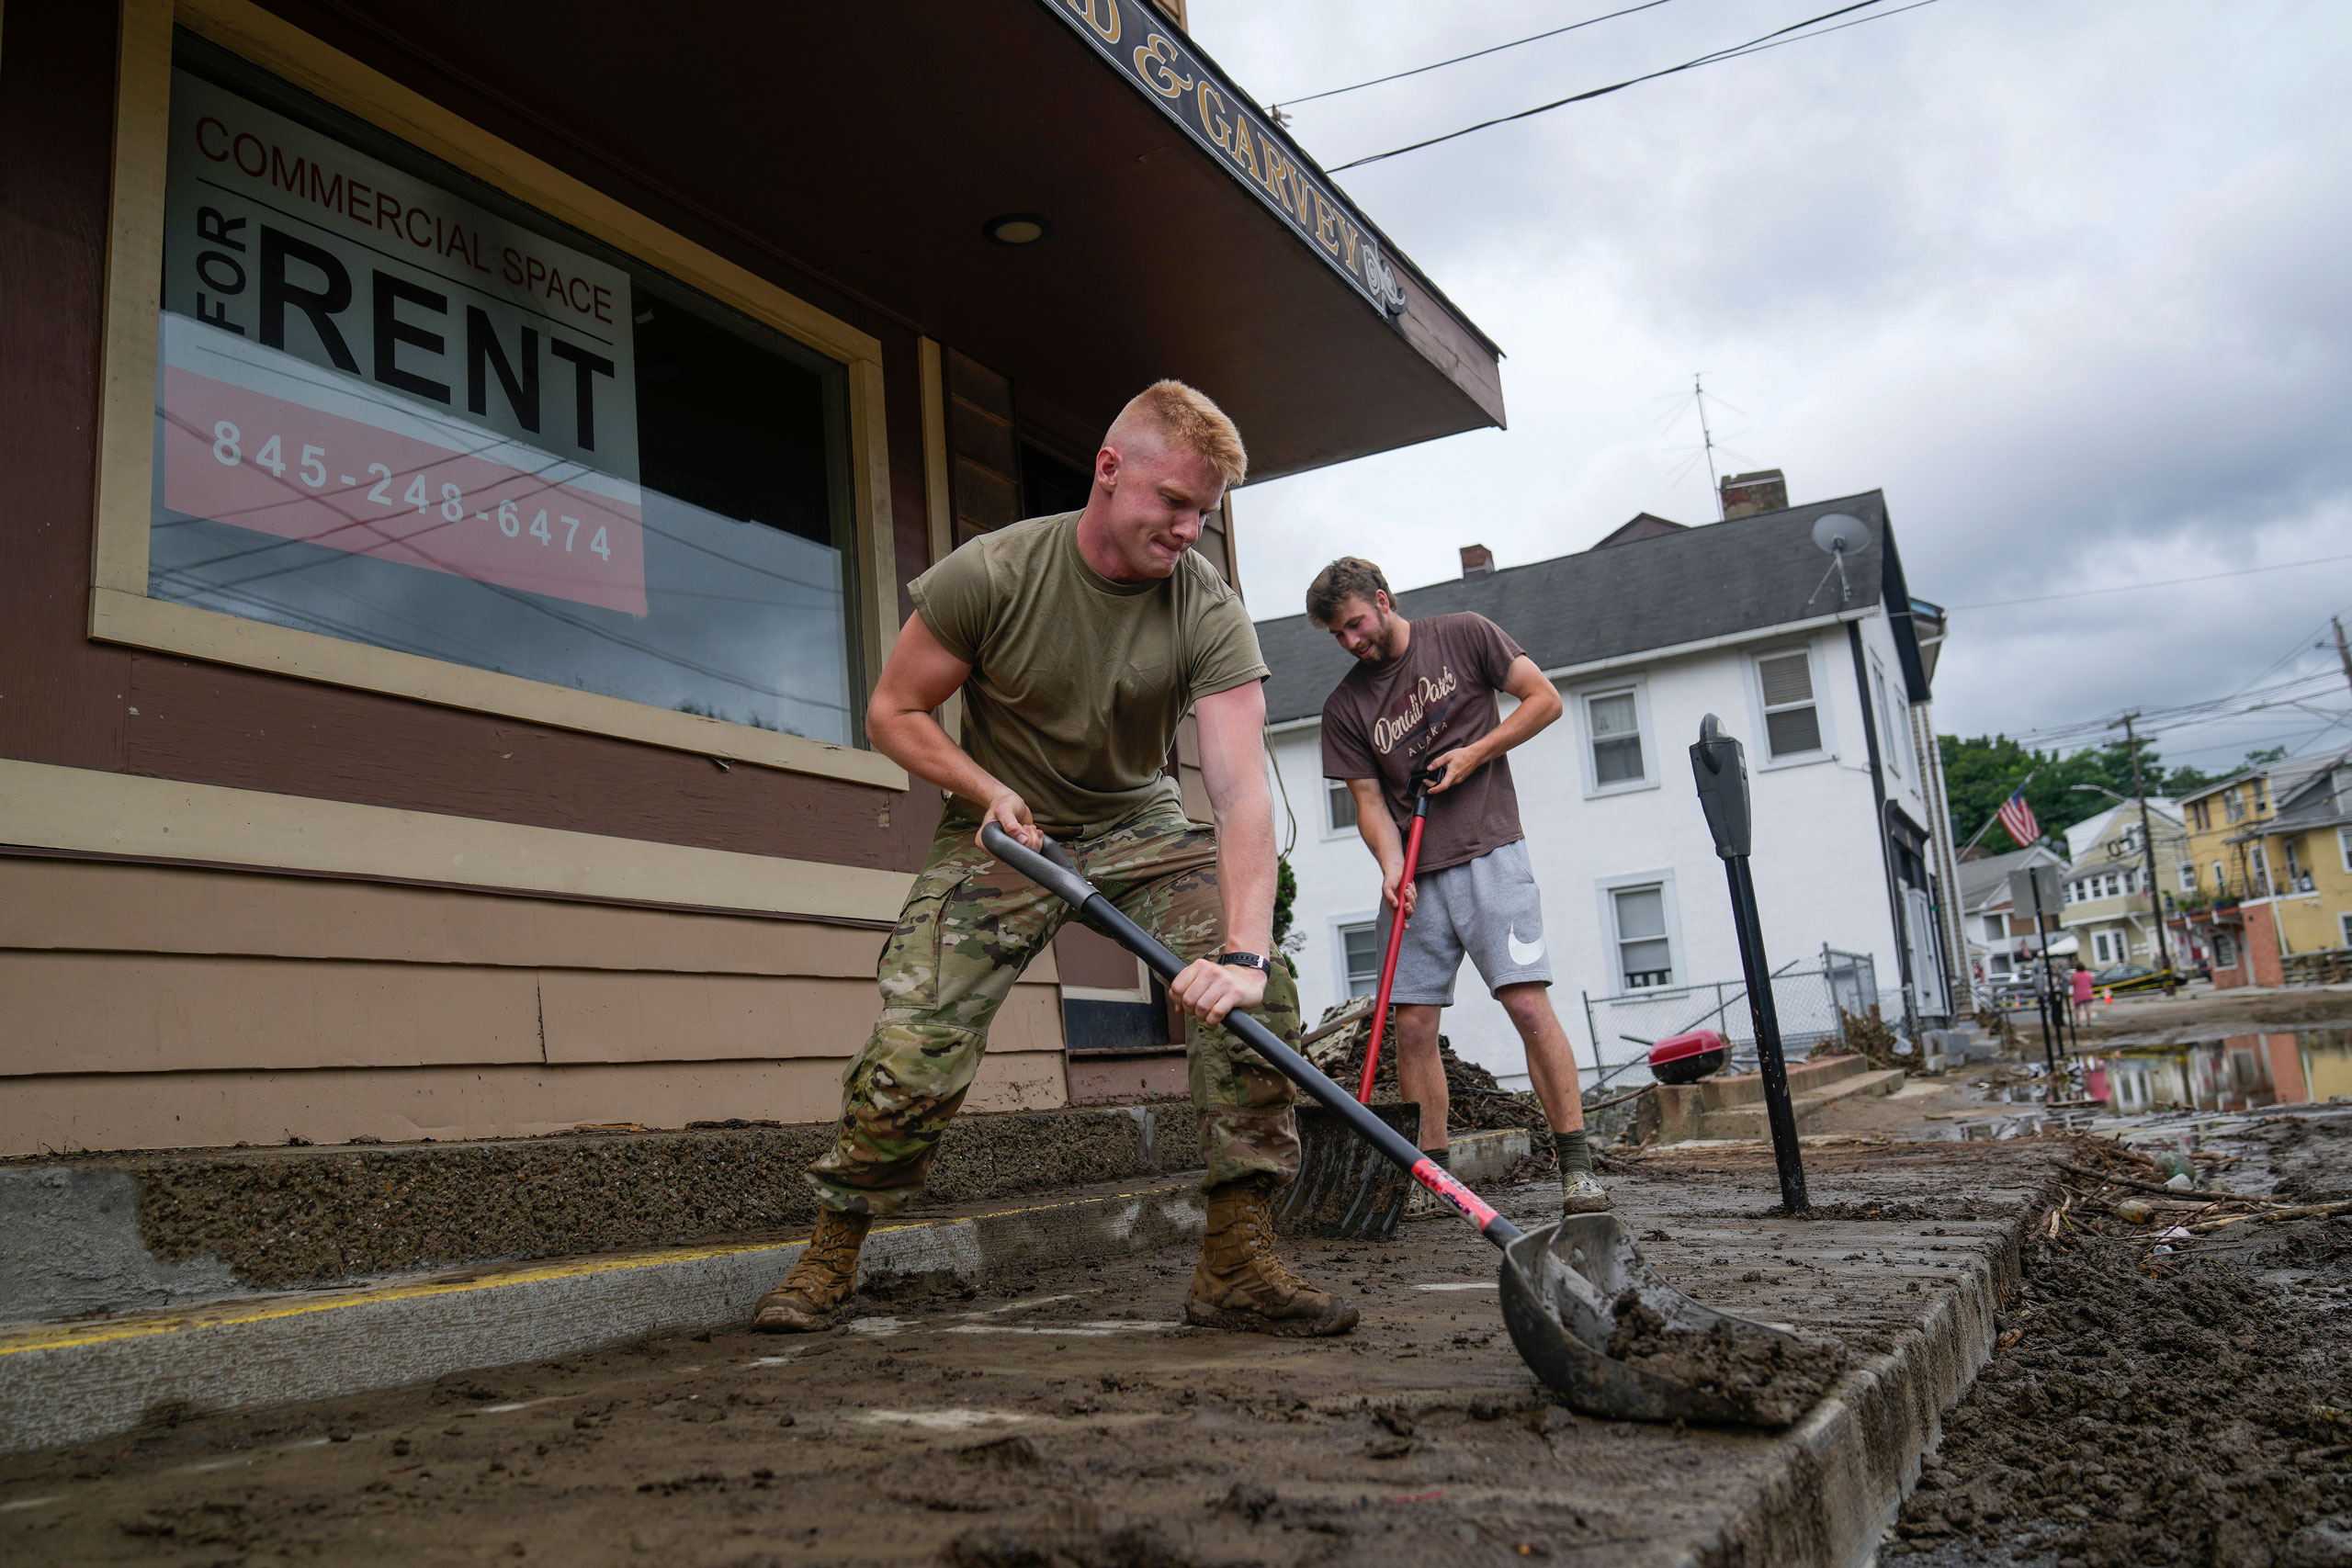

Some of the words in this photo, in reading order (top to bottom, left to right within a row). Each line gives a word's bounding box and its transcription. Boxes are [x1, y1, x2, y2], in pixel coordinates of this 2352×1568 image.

[196, 117, 492, 275] COMMERCIAL
[503, 247, 614, 325] SPACE
[1133, 33, 1193, 98] &
[1197, 80, 1359, 276] GARVEY
[196, 205, 247, 336] FOR
[259, 223, 615, 453] RENT
[212, 420, 613, 562] 845-248-6474
[1374, 694, 1424, 755] Denali
[1417, 666, 1457, 707] Park
